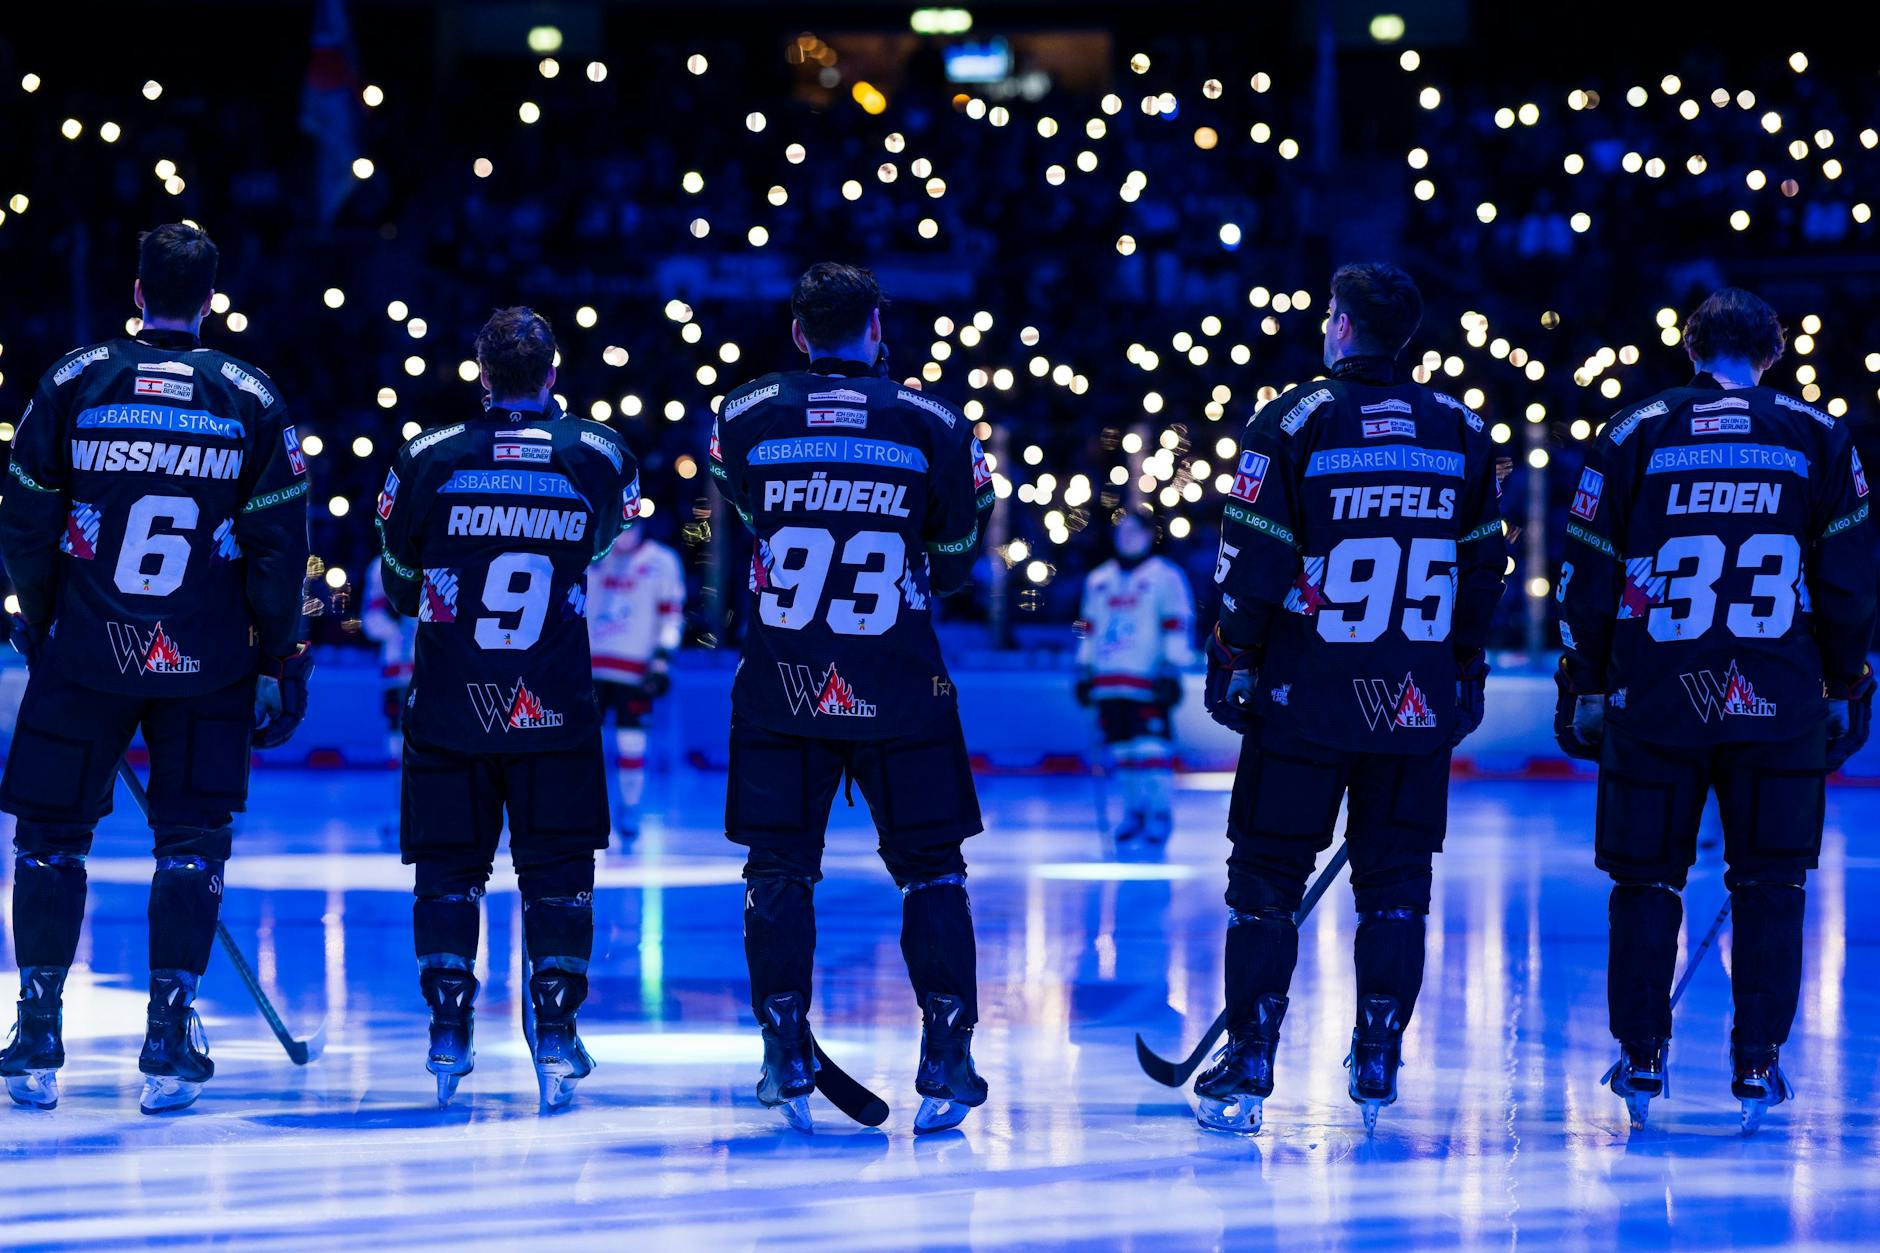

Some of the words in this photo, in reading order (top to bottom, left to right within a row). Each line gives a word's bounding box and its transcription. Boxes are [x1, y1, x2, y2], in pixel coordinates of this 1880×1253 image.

[224, 362, 274, 403] structure
[1609, 400, 1665, 440] structure
[71, 439, 244, 480] WISSMANN
[758, 440, 837, 460] EISBÄREN
[1316, 450, 1397, 471] EISBÄREN
[256, 494, 279, 508] LIGO
[763, 472, 911, 518] PFÖDERL
[1329, 485, 1456, 520] TIFFELS
[1666, 482, 1782, 515] LEDEN
[448, 505, 588, 542] RONNING
[1246, 513, 1268, 530] LIGO
[1270, 524, 1294, 543] LIGO
[113, 494, 200, 597] 6
[938, 543, 964, 553] LIGO
[758, 526, 906, 636] 93
[1316, 536, 1457, 643] 95
[1647, 534, 1802, 642] 33
[474, 552, 555, 651] 9
